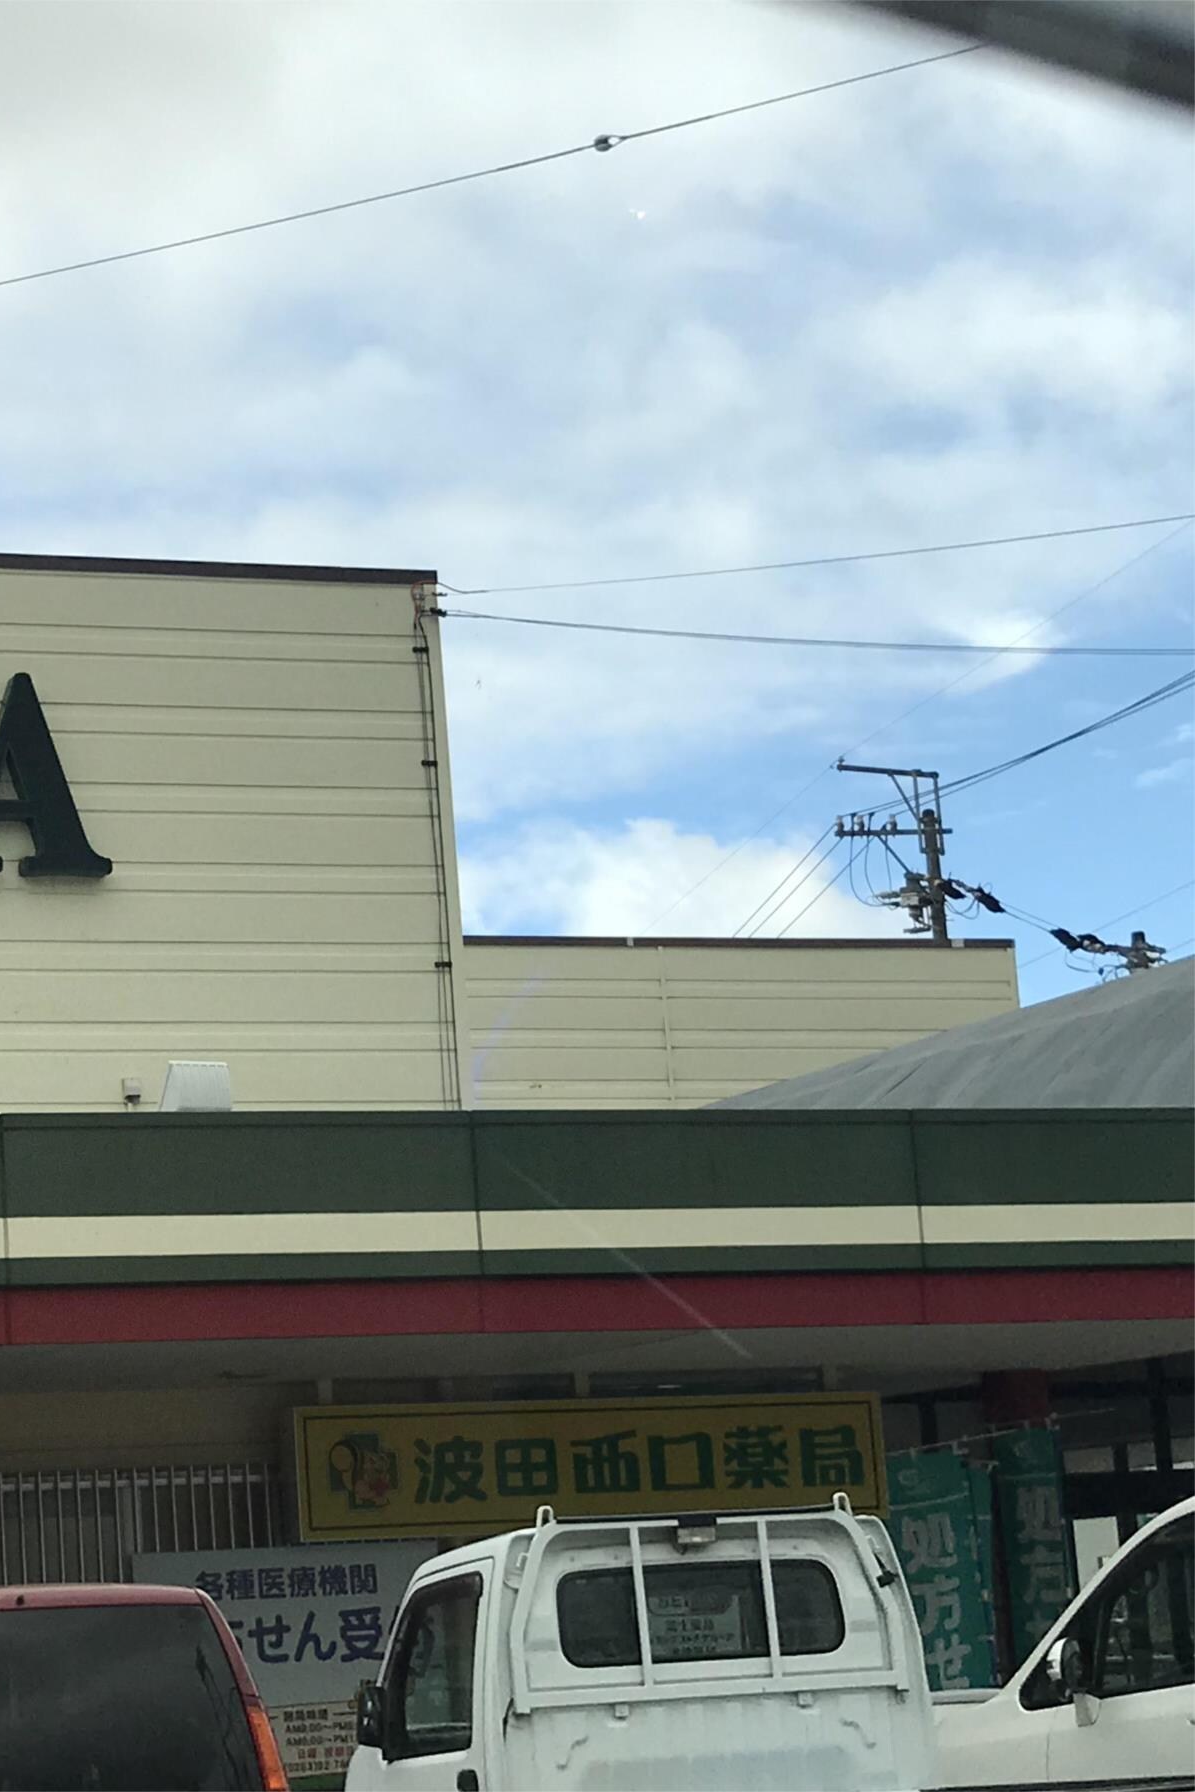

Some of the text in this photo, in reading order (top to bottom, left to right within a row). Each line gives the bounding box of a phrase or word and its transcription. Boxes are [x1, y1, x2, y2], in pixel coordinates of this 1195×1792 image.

[414, 1424, 864, 1504] 波田西口薬局
[196, 1564, 378, 1601] 各種医療機関
